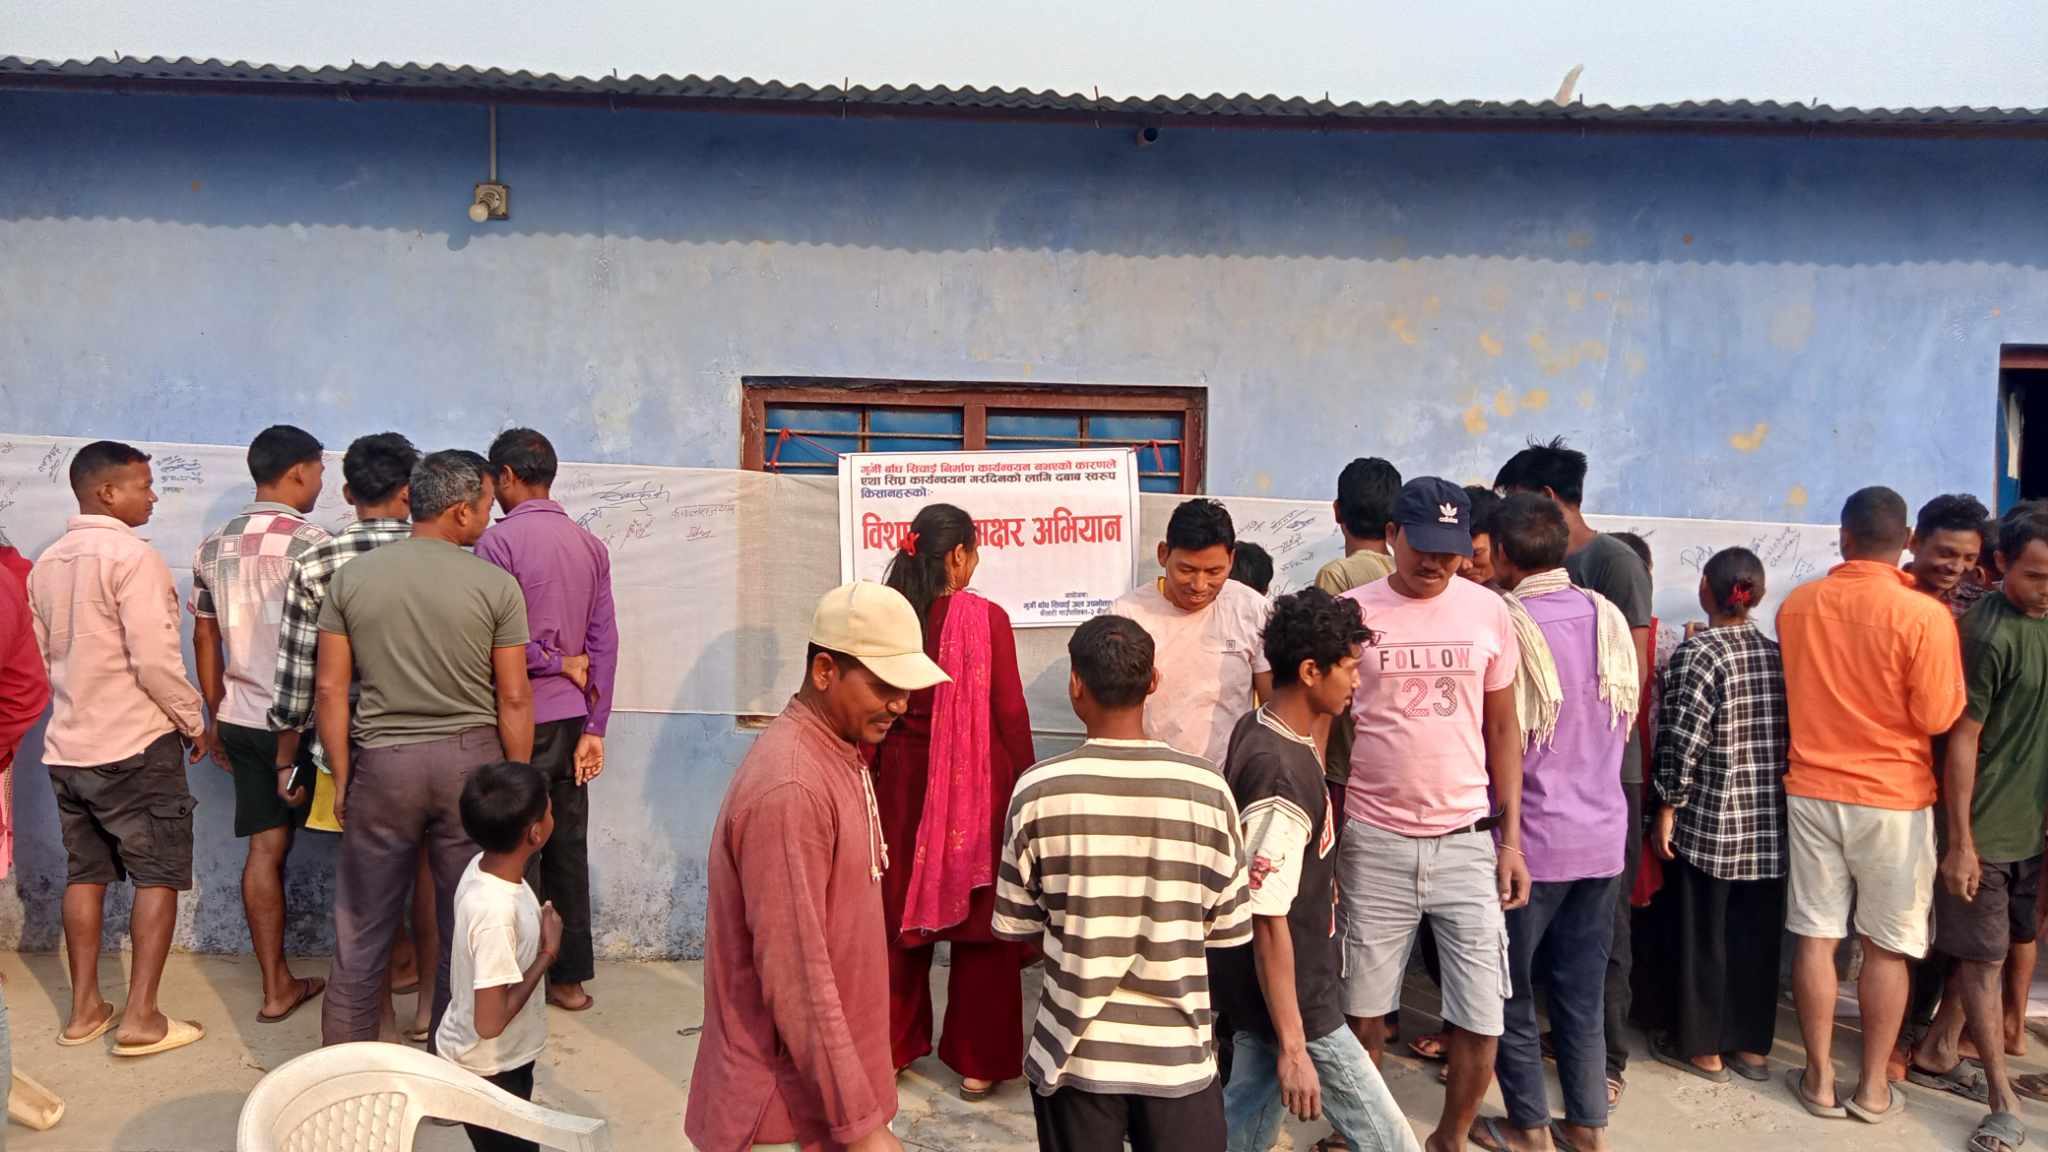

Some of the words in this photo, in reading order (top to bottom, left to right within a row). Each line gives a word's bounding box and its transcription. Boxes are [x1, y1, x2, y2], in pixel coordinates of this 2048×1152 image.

[1075, 459, 1117, 469] कारणले
[1025, 471, 1052, 482] लागि
[1032, 506, 1122, 545] अभियान
[1379, 648, 1470, 670] FOLLOW
[1401, 676, 1458, 717] 23
